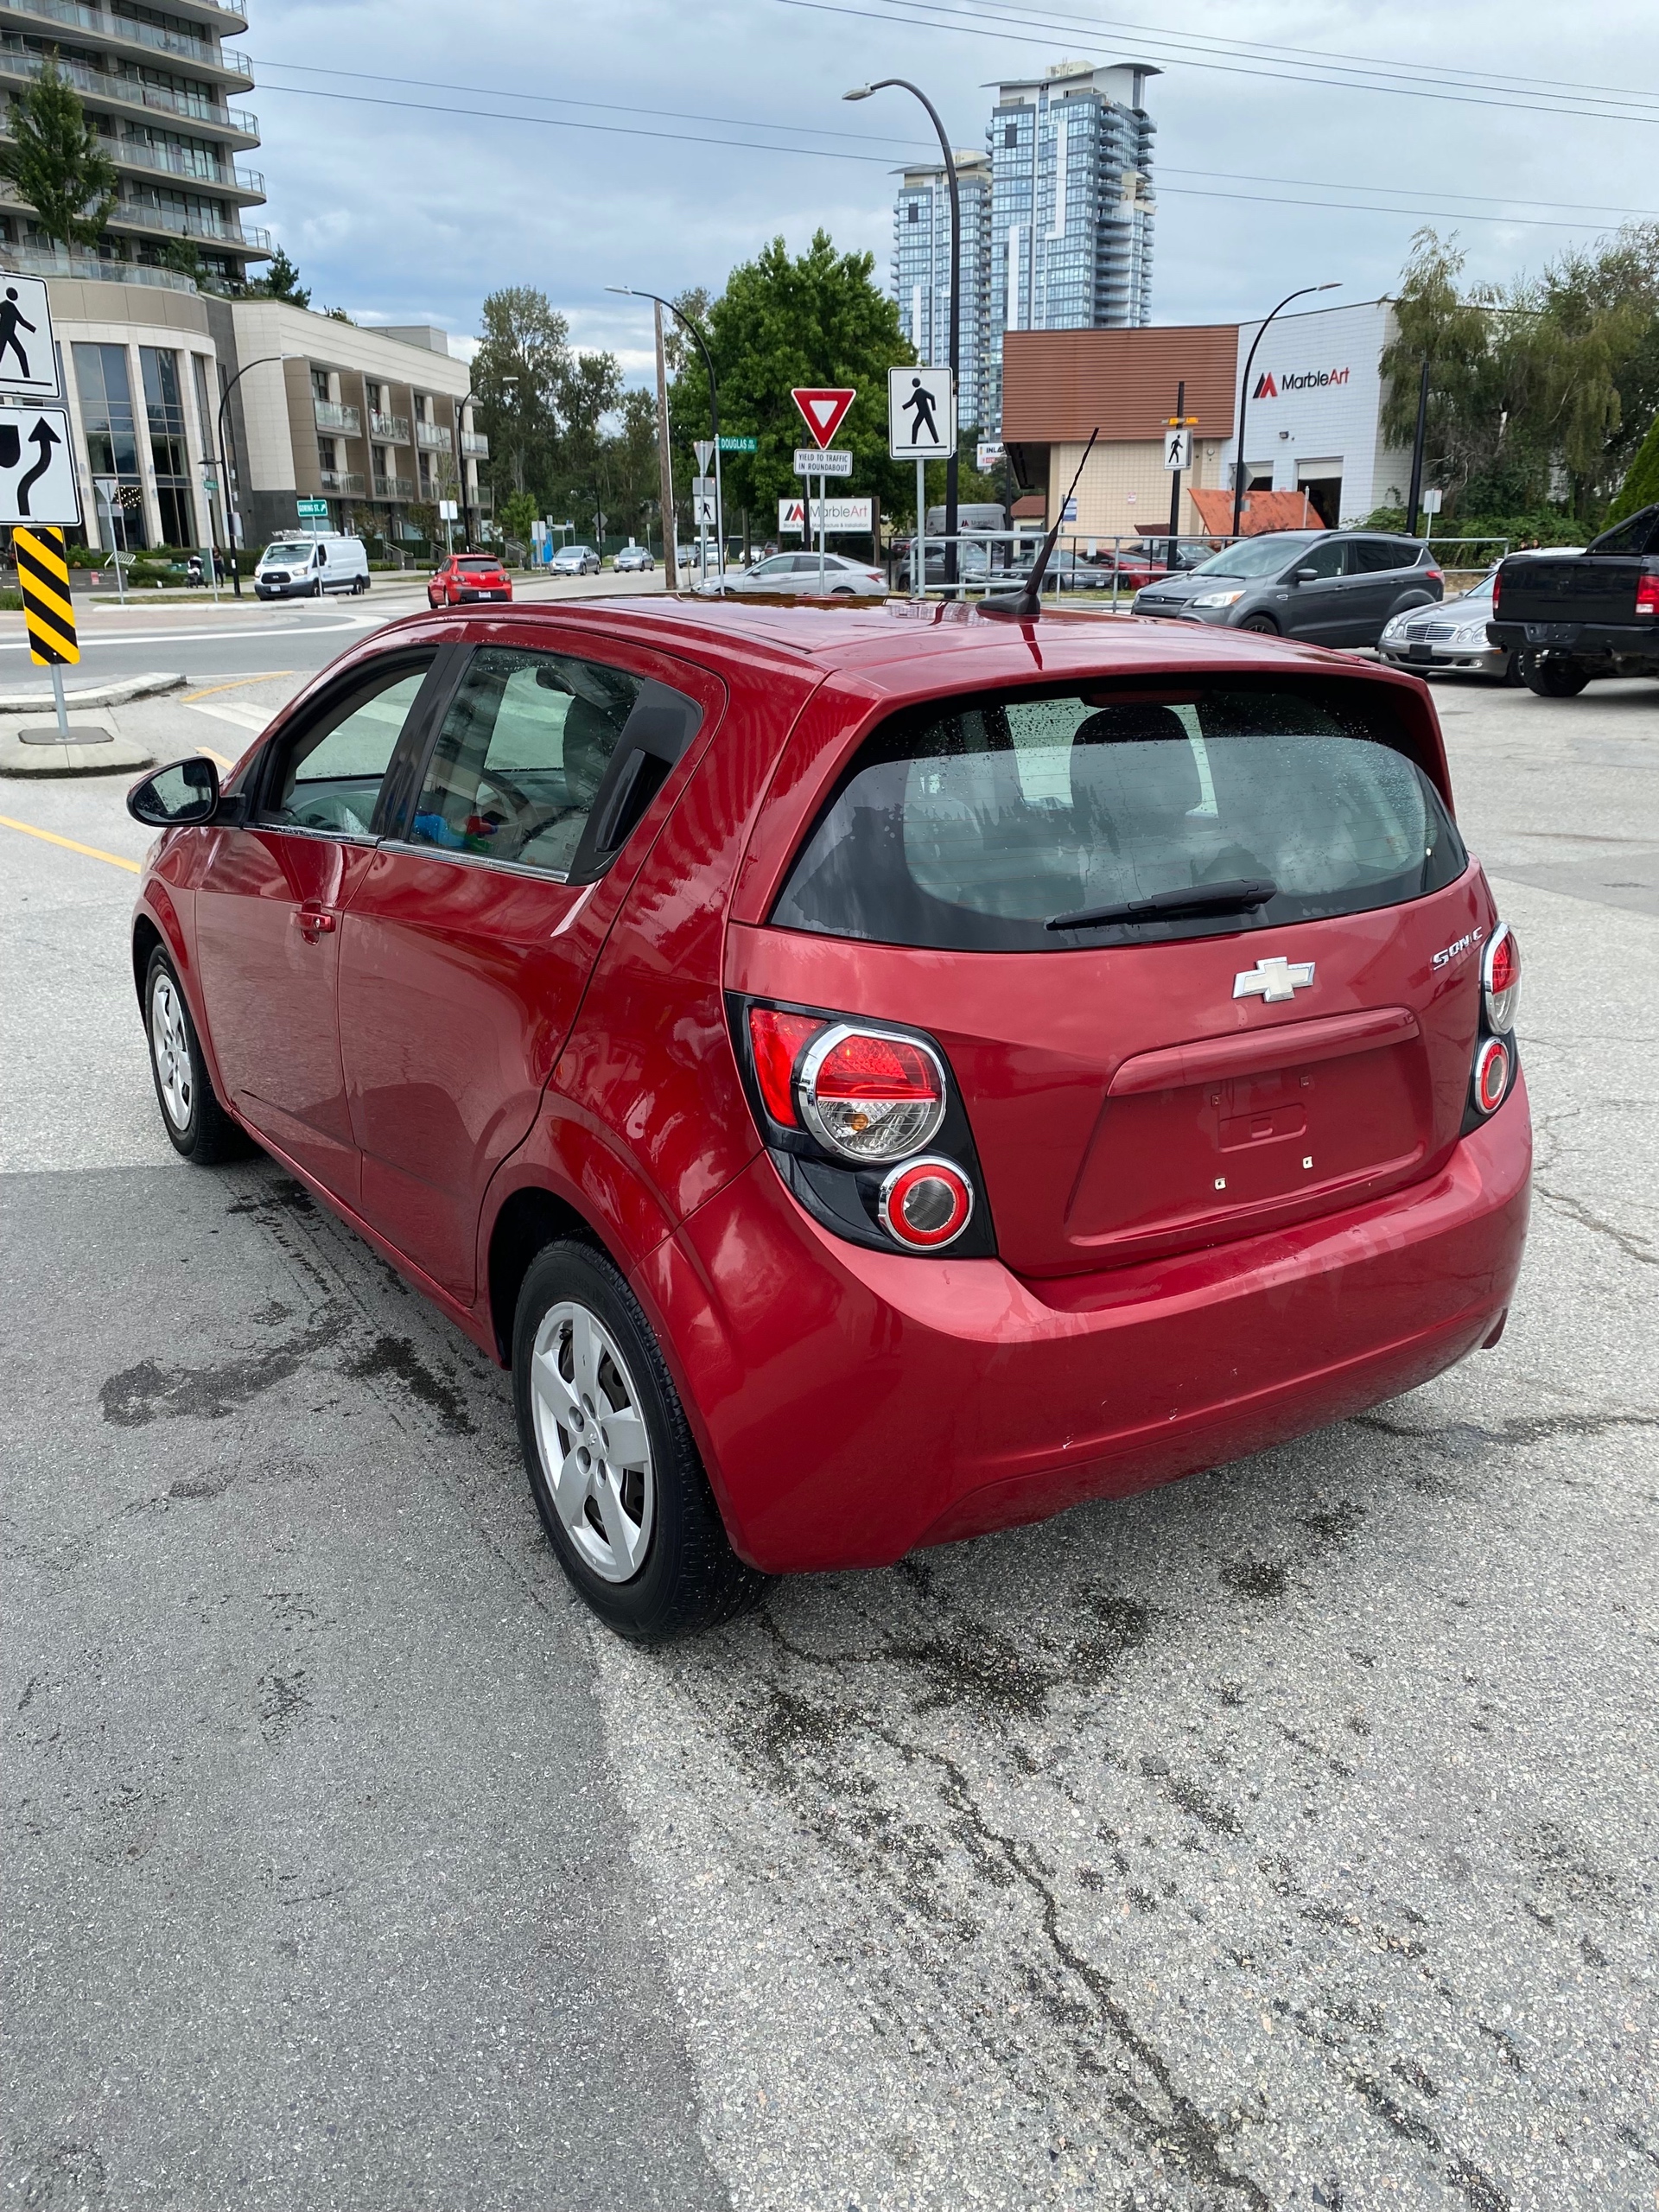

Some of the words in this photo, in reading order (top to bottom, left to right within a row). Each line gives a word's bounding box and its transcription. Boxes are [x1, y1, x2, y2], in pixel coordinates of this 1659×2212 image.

[1281, 366, 1350, 391] MarbleArt
[721, 438, 747, 449] DOUGLAS
[808, 463, 848, 472] ROUNDABOUT
[1432, 925, 1483, 971] SONIC
